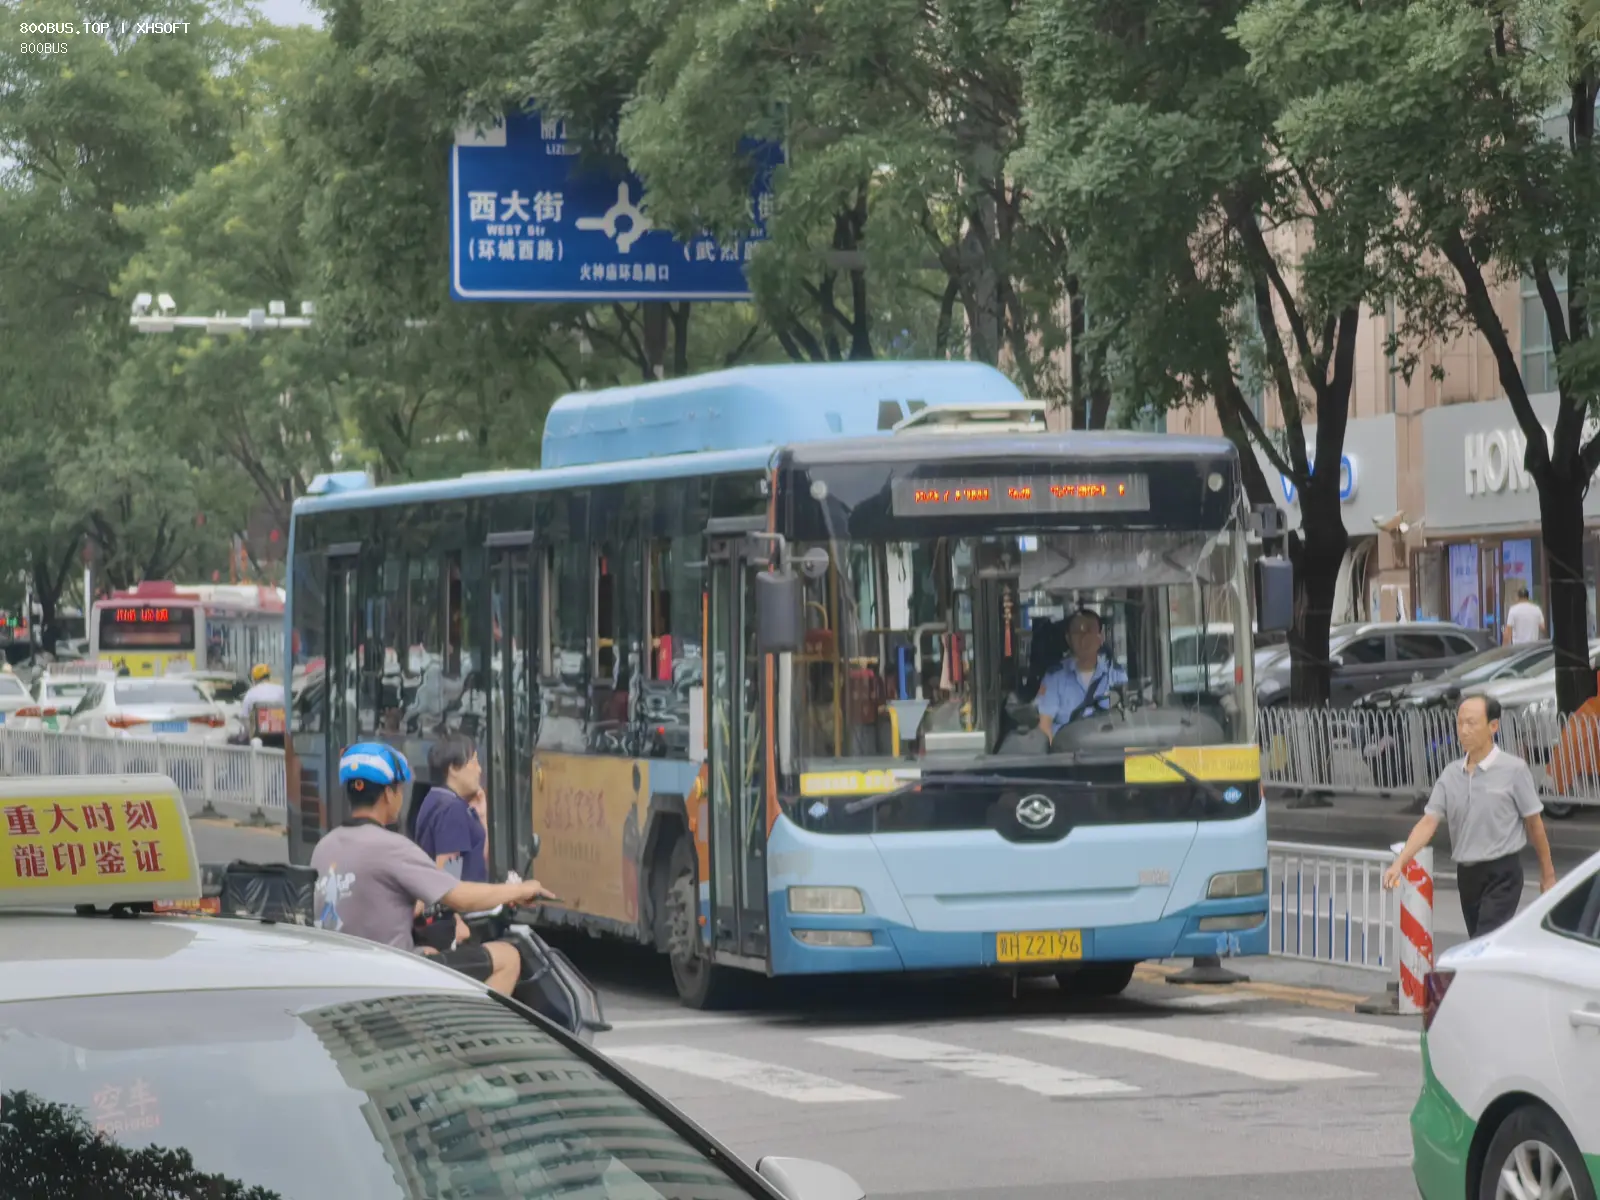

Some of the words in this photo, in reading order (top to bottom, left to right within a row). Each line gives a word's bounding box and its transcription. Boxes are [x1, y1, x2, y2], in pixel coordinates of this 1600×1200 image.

[468, 190, 564, 222] 西大街
[4, 800, 159, 836] 重大时刻
[13, 839, 166, 878] 龍印鉴证
